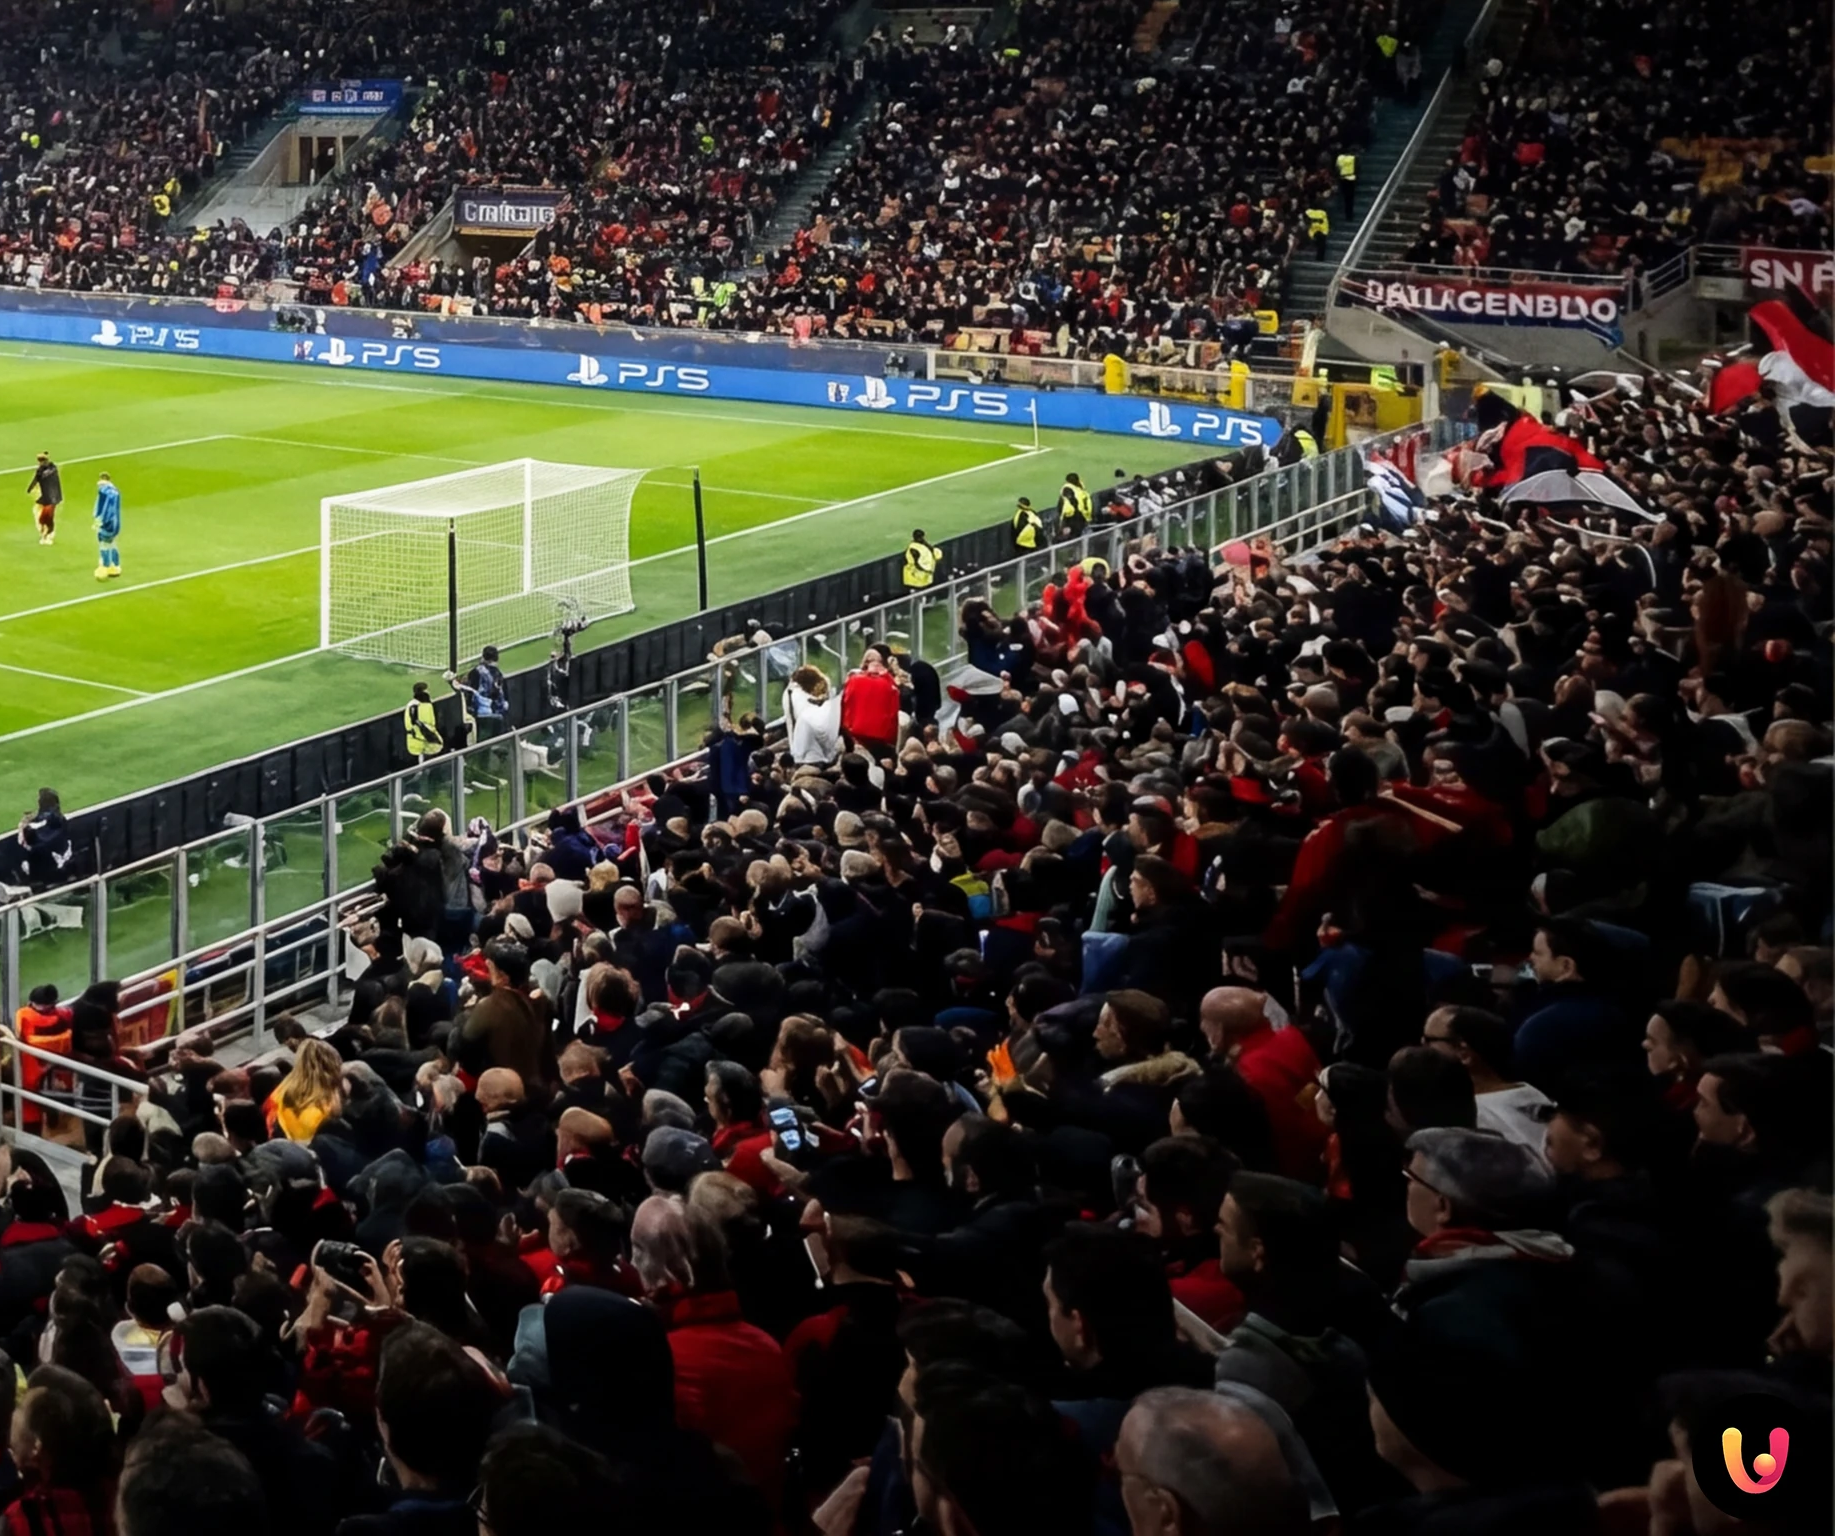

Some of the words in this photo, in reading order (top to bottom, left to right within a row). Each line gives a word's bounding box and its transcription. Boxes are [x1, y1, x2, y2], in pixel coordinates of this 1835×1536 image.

[361, 342, 441, 369] PS5
[618, 362, 710, 392] PS5
[906, 384, 1009, 417] PS5
[1191, 412, 1263, 446] PS5
